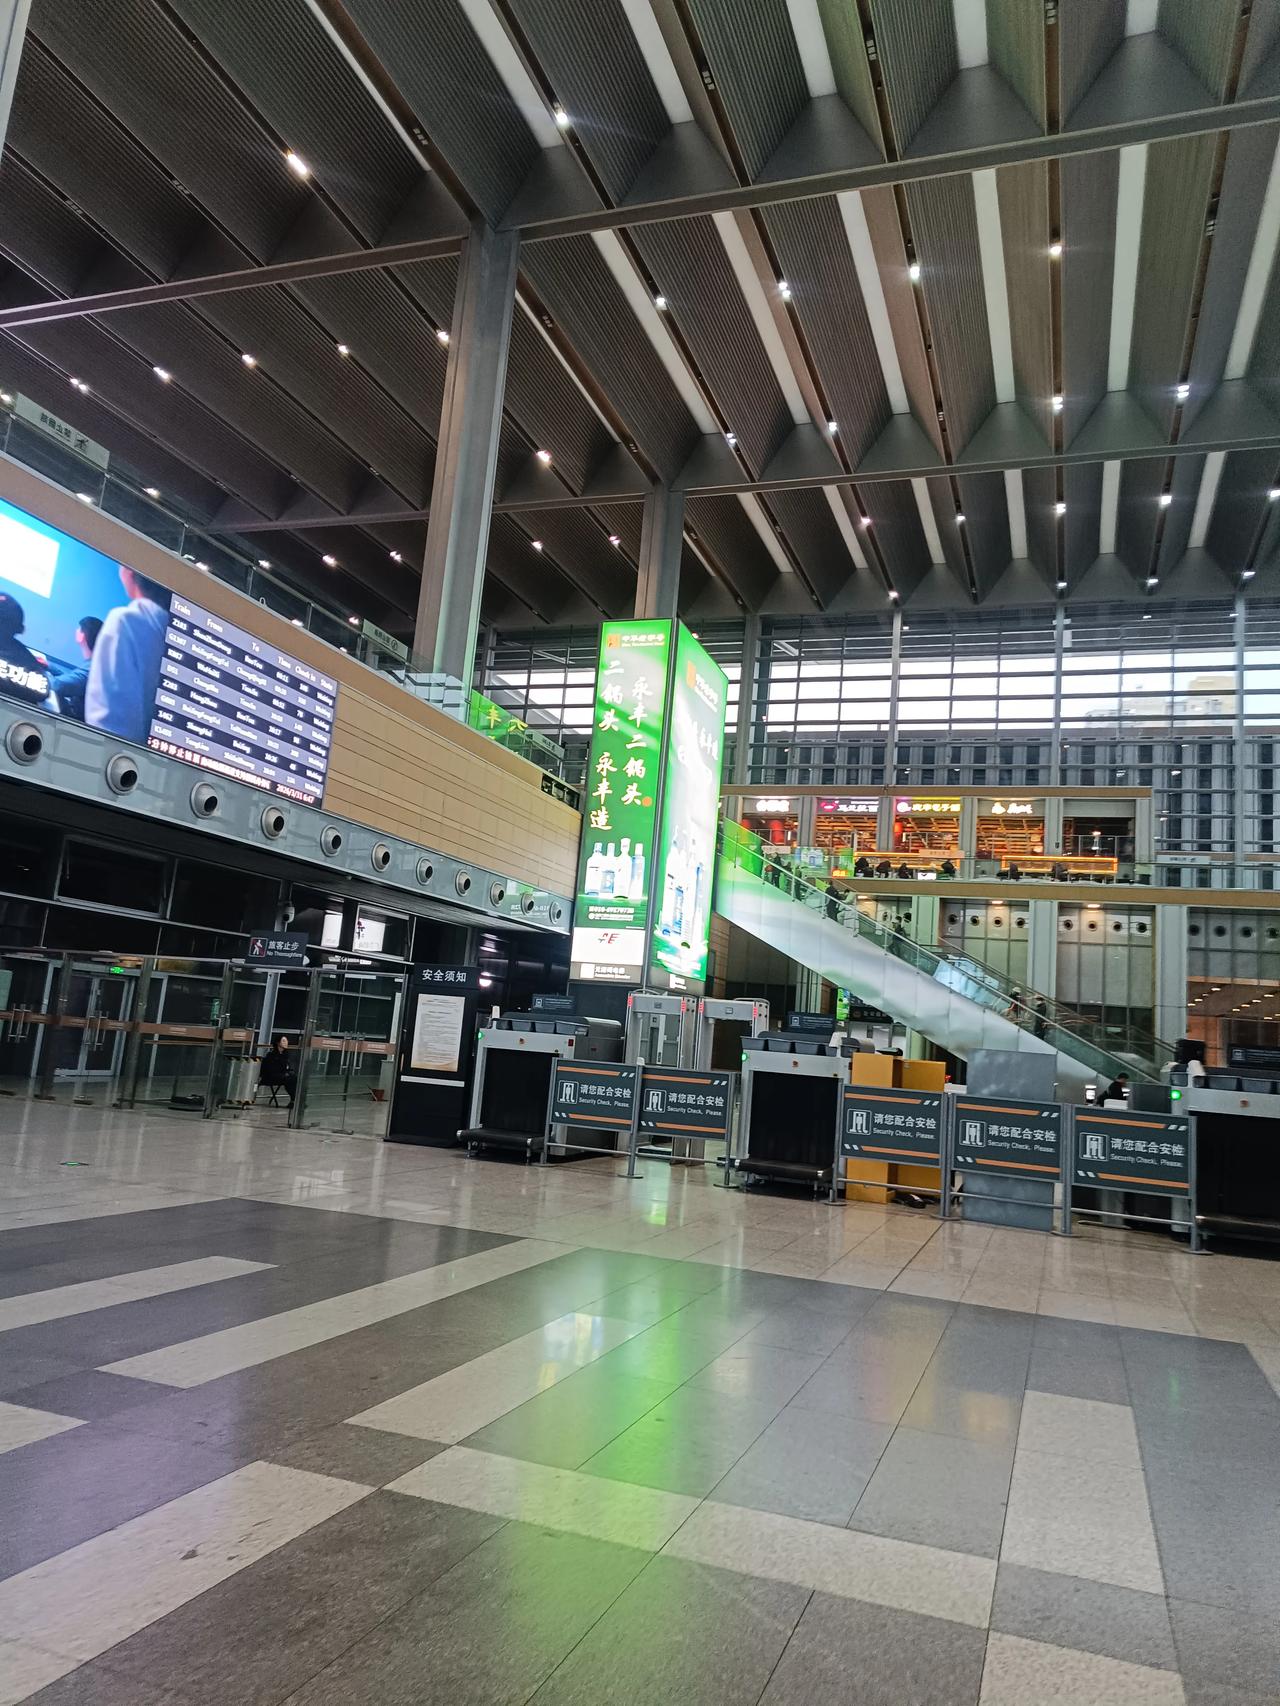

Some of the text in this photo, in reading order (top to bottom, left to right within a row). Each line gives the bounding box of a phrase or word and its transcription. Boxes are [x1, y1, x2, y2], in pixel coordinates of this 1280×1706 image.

[174, 601, 191, 616] Train
[621, 676, 654, 806] 永丰二锅头
[268, 940, 300, 951] 旅客止步
[422, 968, 467, 983] 安全须知
[580, 1084, 632, 1099] 请您配合安检
[578, 1097, 596, 1106] Security
[668, 1092, 724, 1107] 请您配合安检
[667, 1105, 686, 1114] Security
[873, 1113, 936, 1129] 请您配合安检
[872, 1127, 894, 1136] Security
[987, 1124, 1057, 1142] 请您配合安检
[987, 1139, 1011, 1149] Security
[1110, 1138, 1185, 1156] 请您配合安检
[1110, 1153, 1136, 1164] Security
